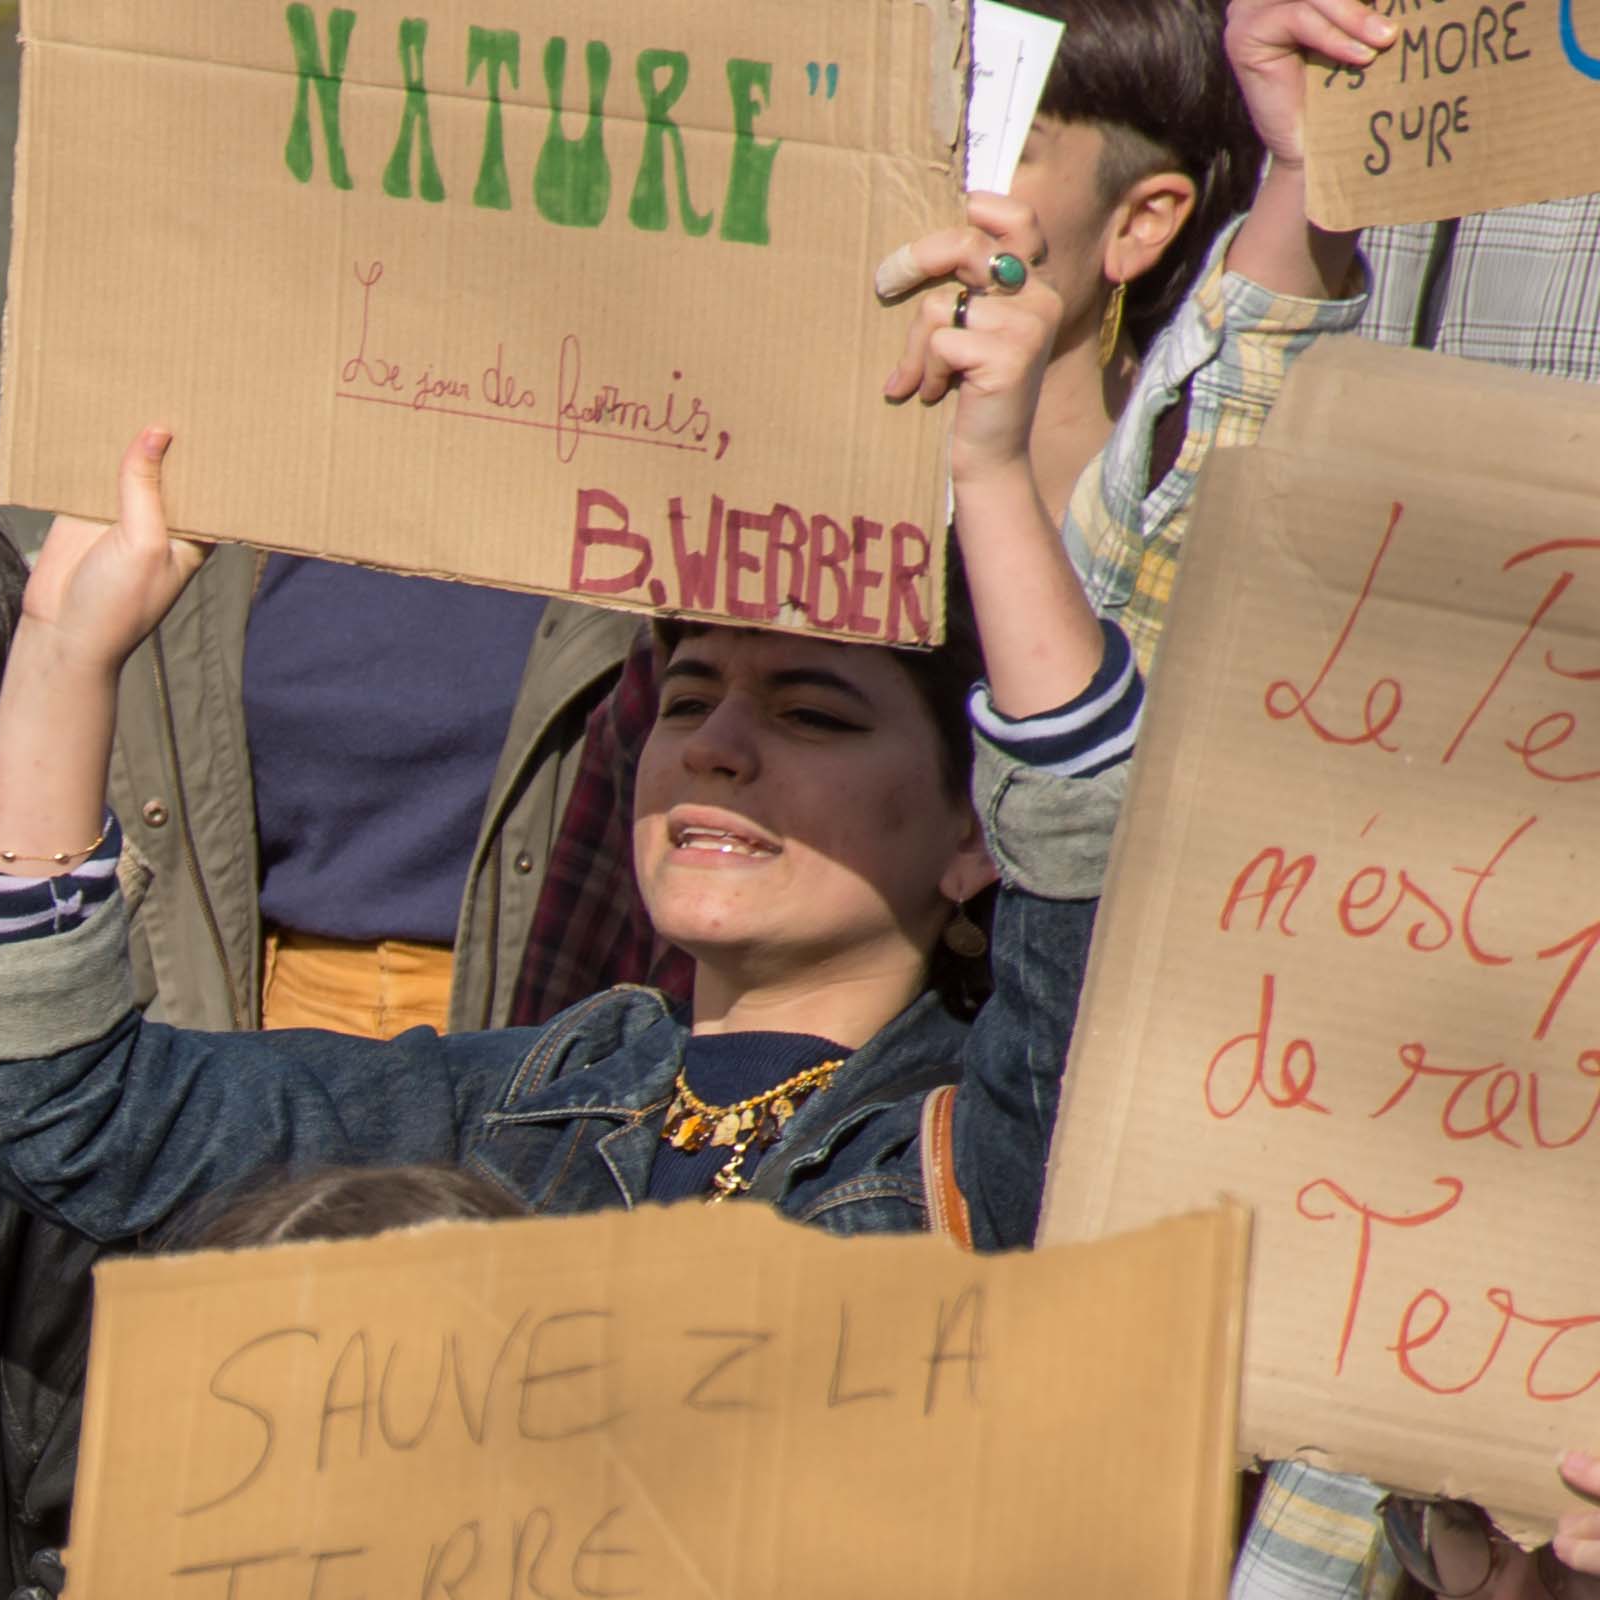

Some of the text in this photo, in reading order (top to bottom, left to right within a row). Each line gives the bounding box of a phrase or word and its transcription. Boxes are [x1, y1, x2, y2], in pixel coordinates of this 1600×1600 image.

[1400, 1, 1531, 82] MORE
[1364, 96, 1470, 175] SURE
[1264, 501, 1404, 752] Le
[1204, 974, 1332, 1119] de
